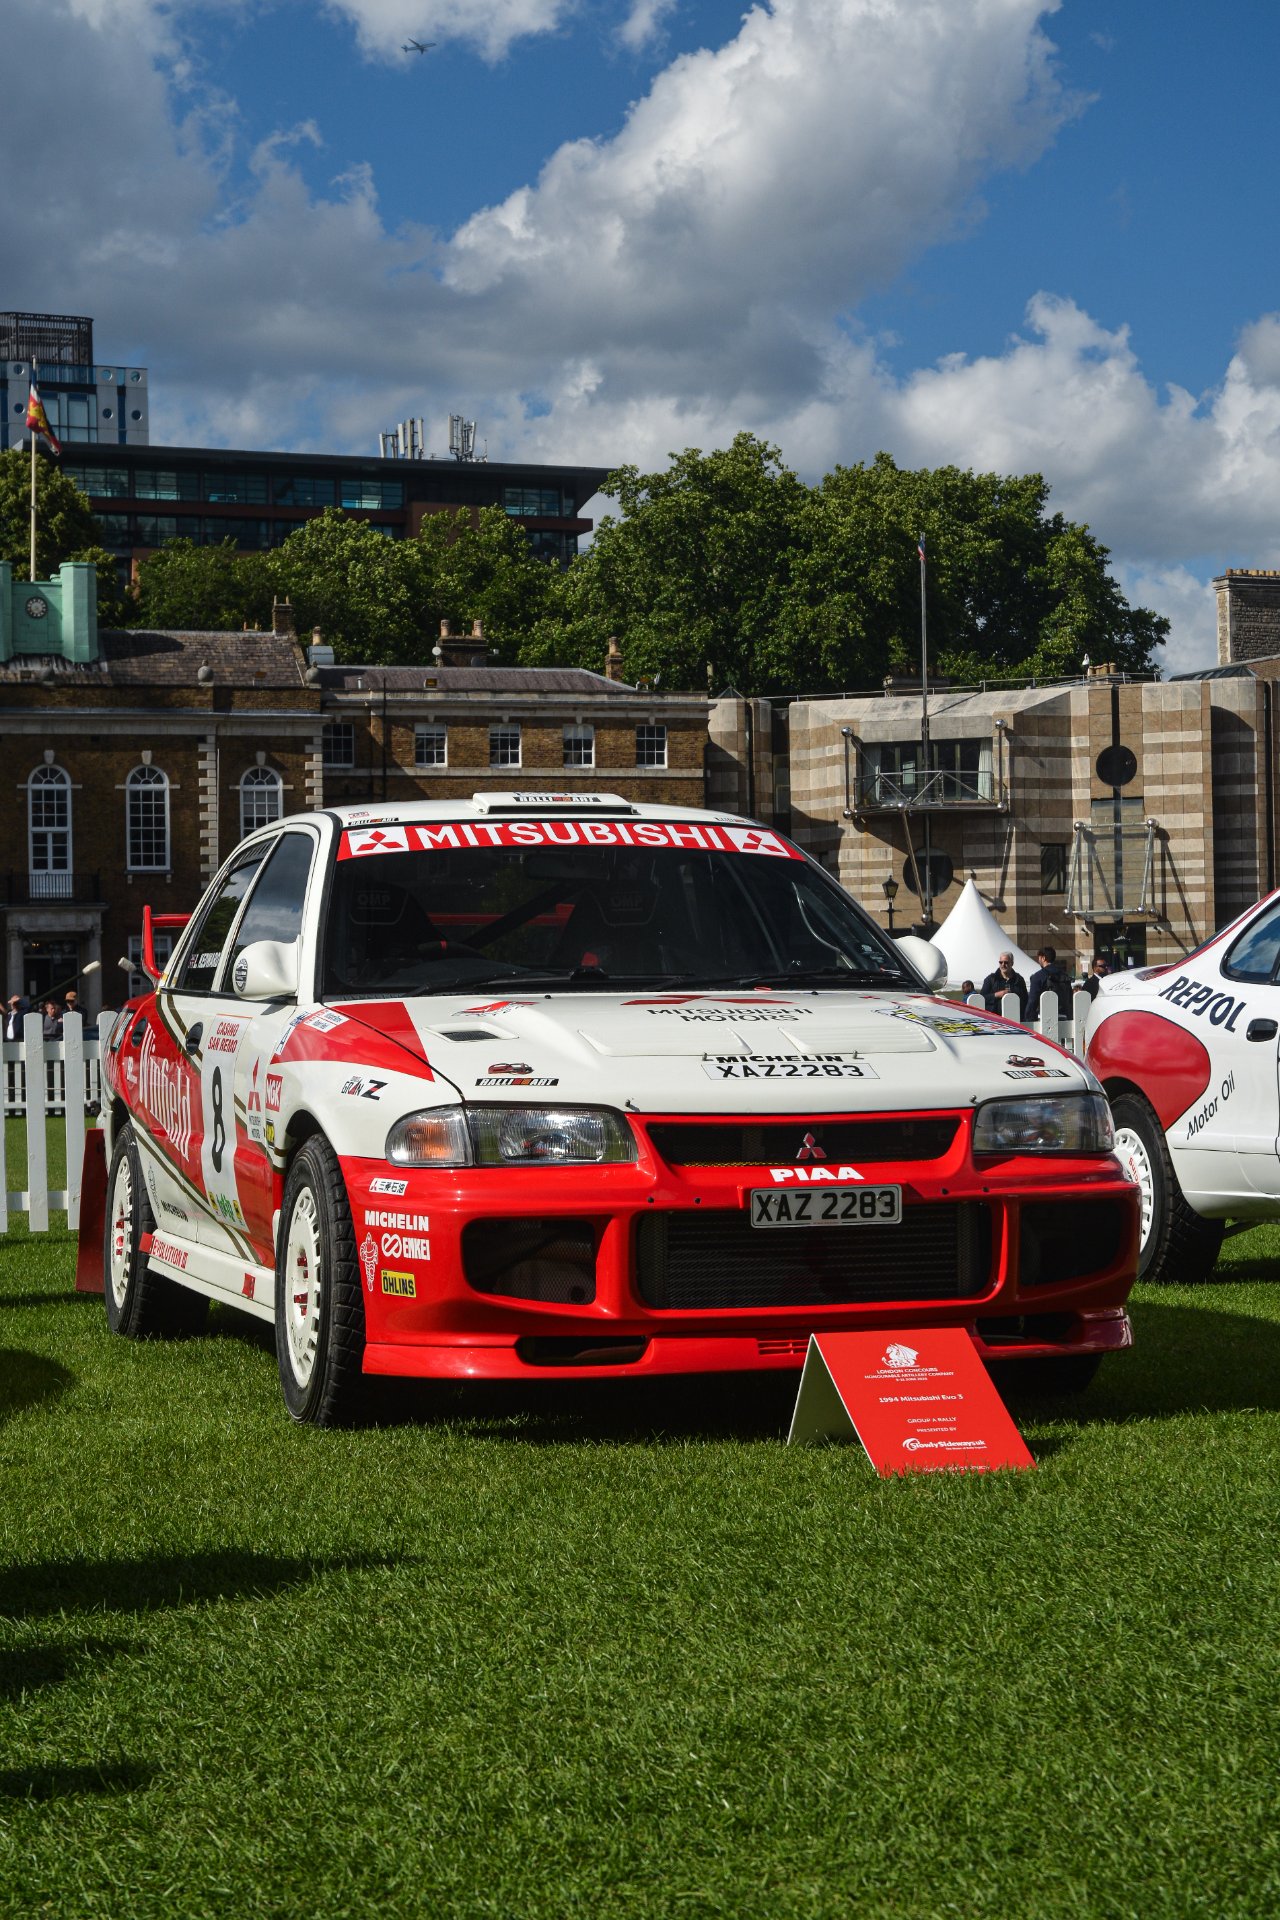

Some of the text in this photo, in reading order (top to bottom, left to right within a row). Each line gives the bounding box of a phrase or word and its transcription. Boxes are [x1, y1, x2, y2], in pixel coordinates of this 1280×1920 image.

[410, 821, 728, 851] MITSUBISHI
[1158, 975, 1247, 1034] REPSOL
[216, 1021, 240, 1037] CASINO
[680, 1014, 799, 1022] MOTORS
[716, 1054, 844, 1064] MICHELIN
[717, 1064, 864, 1078] XAZ2283
[266, 1078, 281, 1108] NGK
[1186, 1069, 1236, 1141] Motor Oil
[211, 1065, 226, 1174] 8
[769, 1166, 865, 1183] PIAA
[755, 1190, 896, 1222] XAZ 2283
[364, 1209, 430, 1232] MICHELIN
[402, 1236, 431, 1261] ENKEI
[382, 1271, 415, 1297] ÖHLINS
[879, 1395, 899, 1403] 1994
[900, 1394, 940, 1402] Mitsubishi
[941, 1393, 957, 1401] Evo
